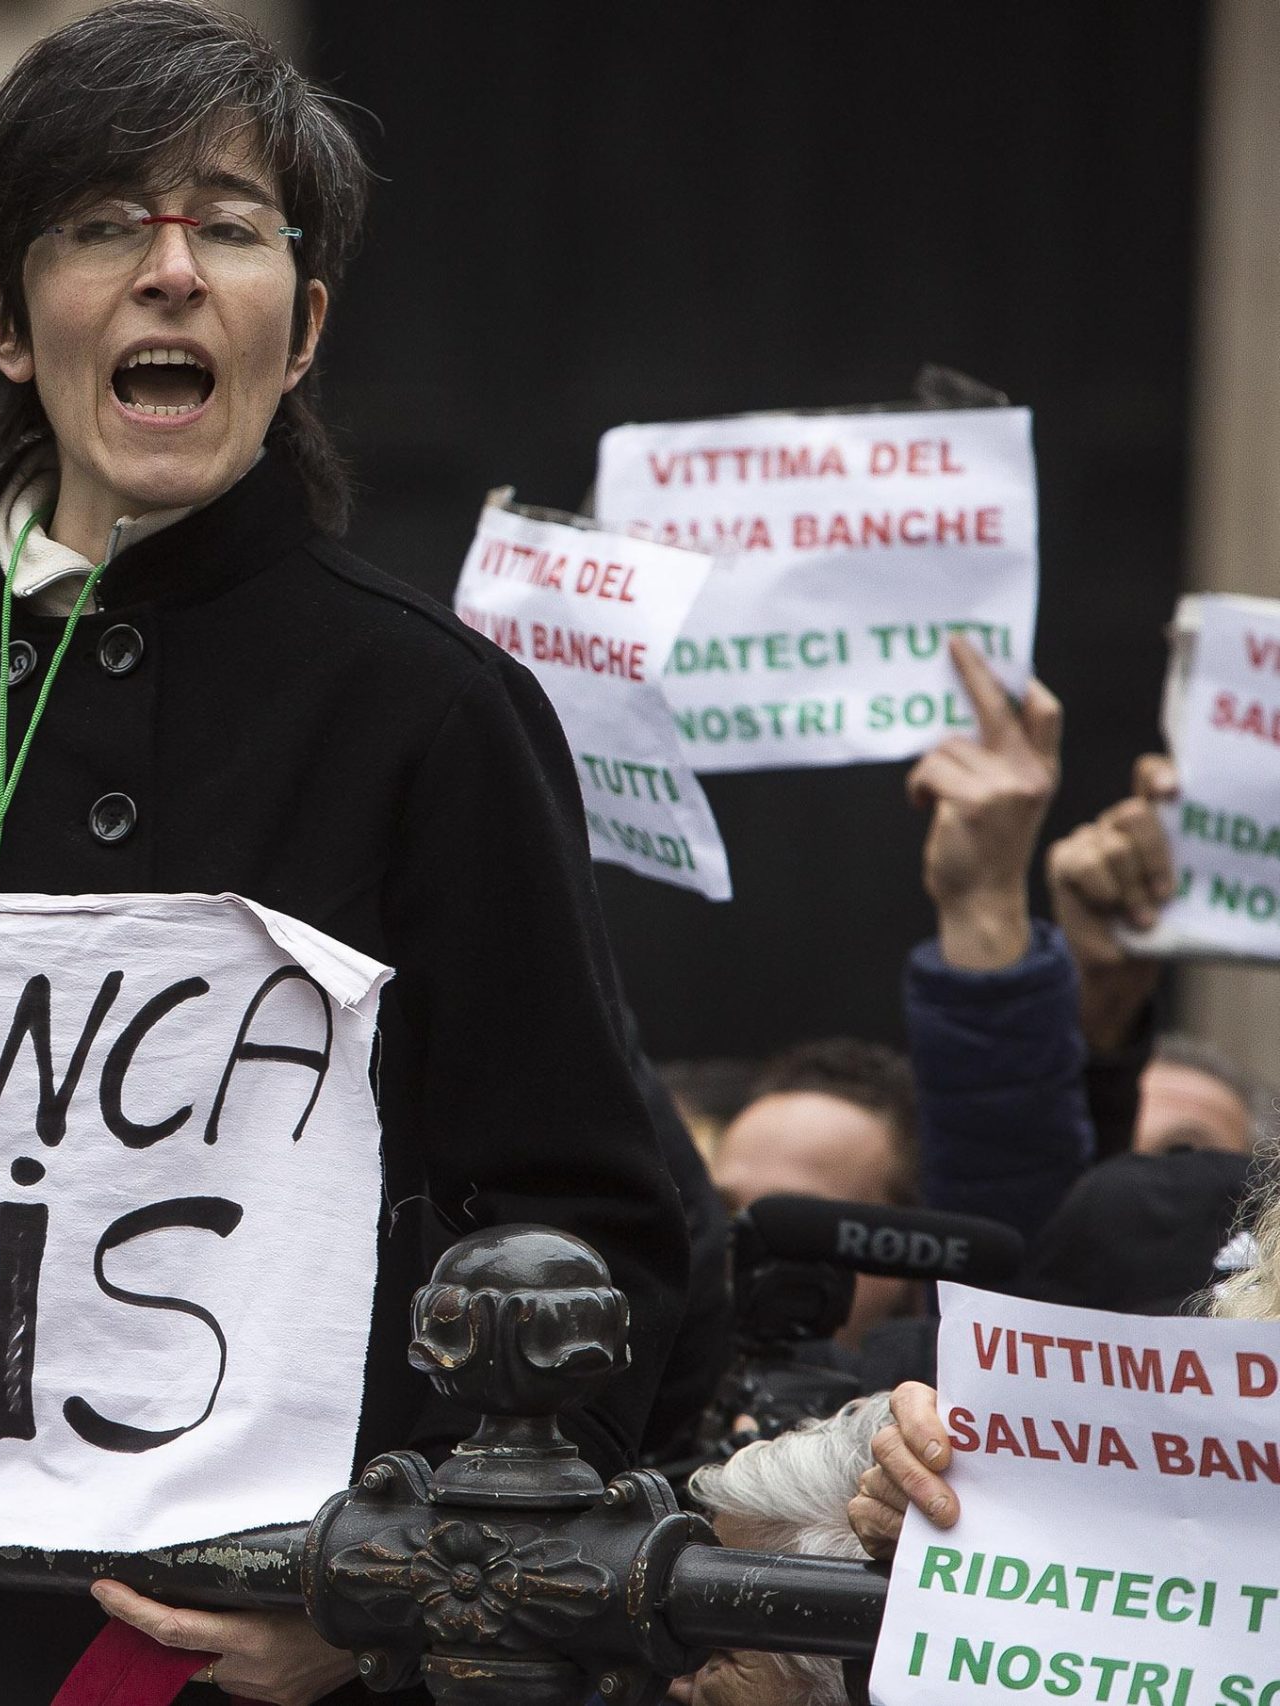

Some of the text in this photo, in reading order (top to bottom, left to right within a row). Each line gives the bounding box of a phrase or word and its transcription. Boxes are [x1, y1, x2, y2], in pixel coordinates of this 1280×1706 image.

[648, 438, 966, 487] VITTIMA DEL
[791, 506, 1004, 549] BANCHE
[576, 559, 635, 603] DEL
[531, 621, 647, 683] BANCHE
[580, 753, 680, 803] TUTTI
[973, 1321, 1214, 1396] VITTIMA
[947, 1406, 1139, 1470] SALVA
[918, 1545, 1217, 1628] RIDATECI
[908, 1631, 929, 1677] I
[948, 1636, 1194, 1706] NOSTRI
